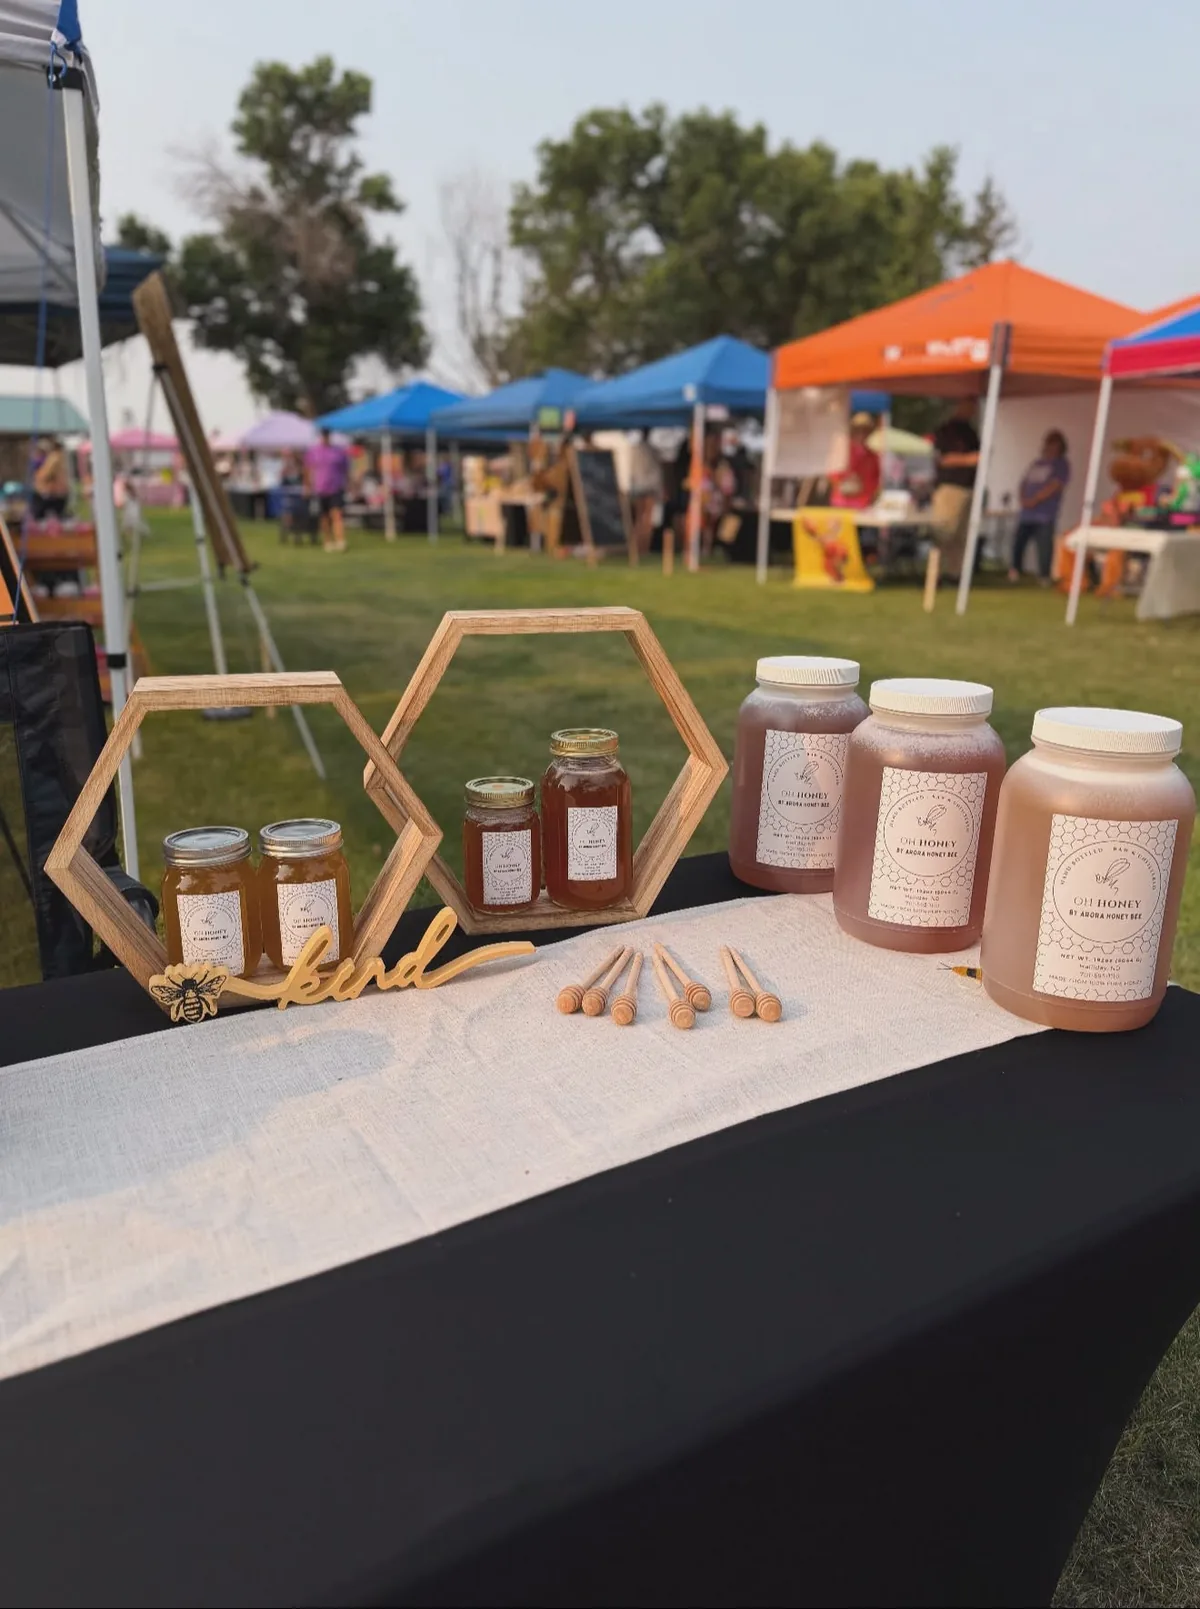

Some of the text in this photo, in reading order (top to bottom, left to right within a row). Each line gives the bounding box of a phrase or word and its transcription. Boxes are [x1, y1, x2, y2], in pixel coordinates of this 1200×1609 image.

[797, 791, 828, 799] HONEY
[900, 837, 956, 848] OH HONEY
[905, 849, 926, 857] ARORA
[926, 850, 946, 858] HONEY
[1071, 847, 1104, 866] BOTTLED
[1073, 896, 1142, 909] OH HONEY
[1080, 911, 1104, 919] ARORA
[1106, 912, 1129, 920] HONEY
